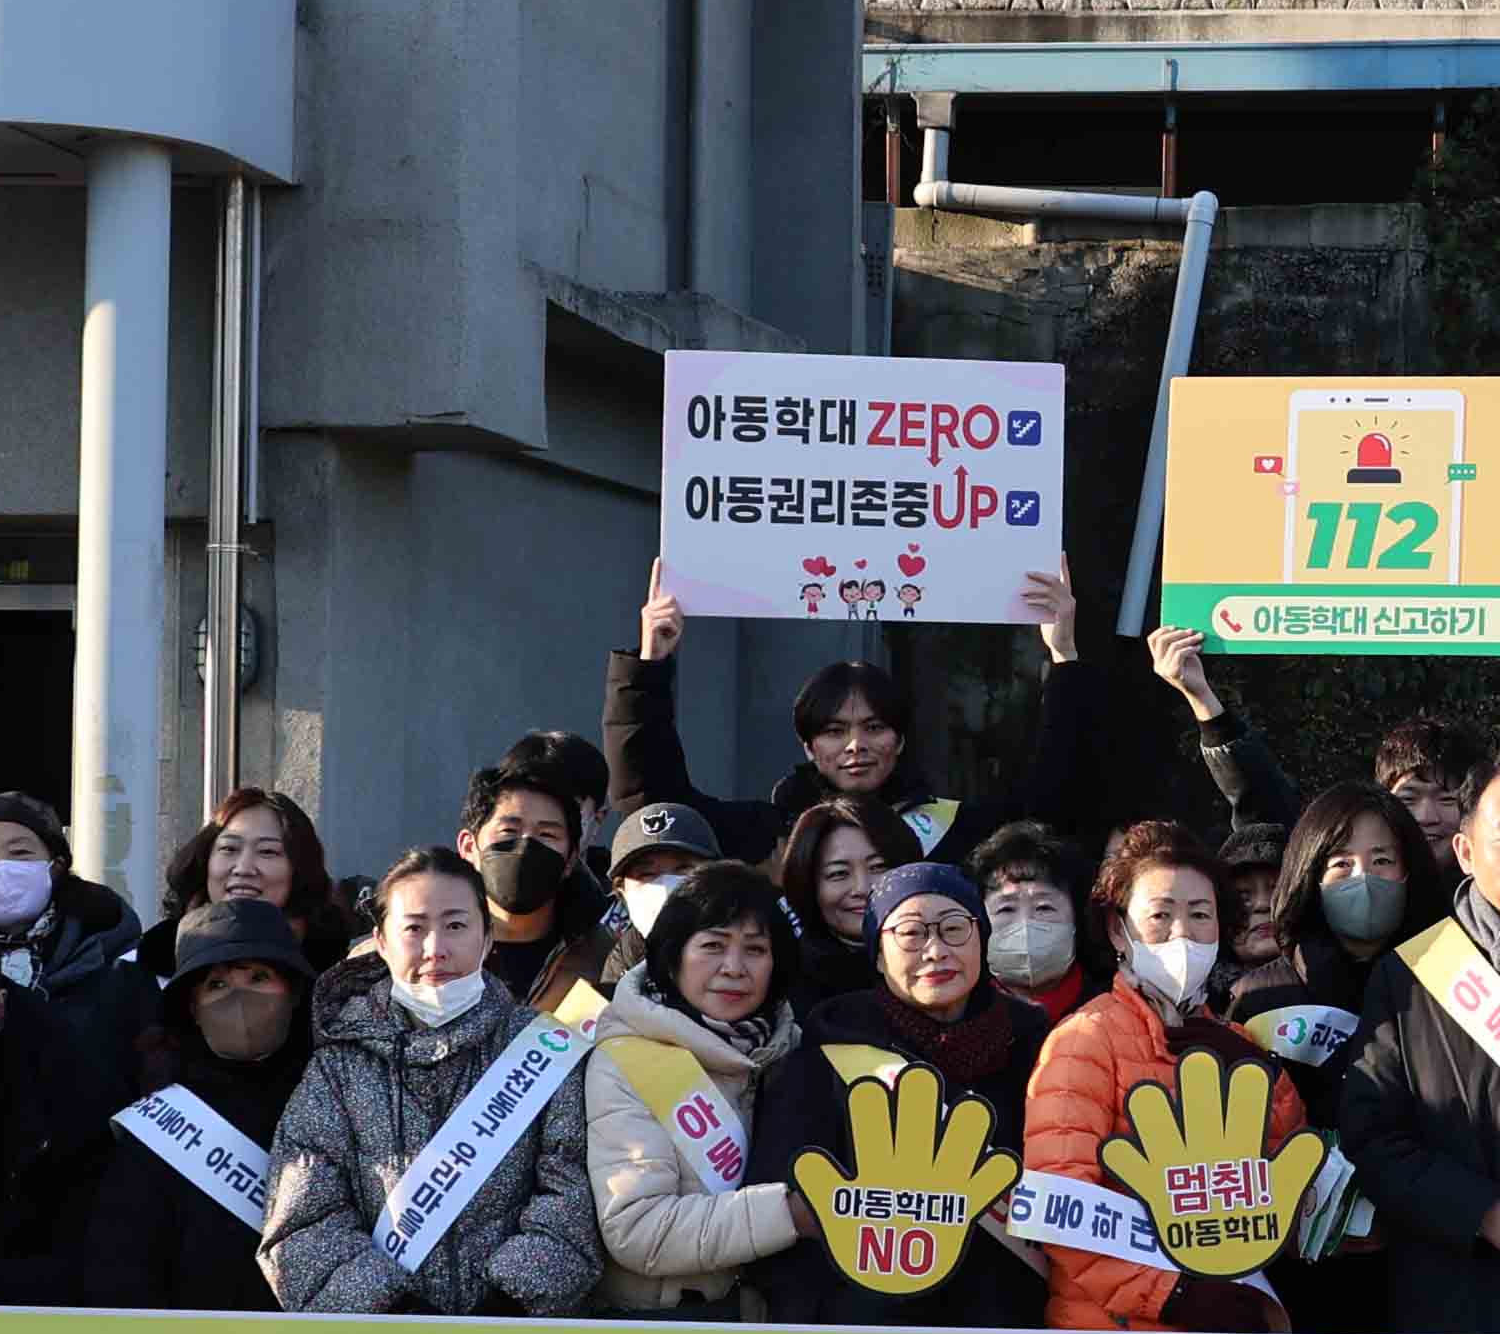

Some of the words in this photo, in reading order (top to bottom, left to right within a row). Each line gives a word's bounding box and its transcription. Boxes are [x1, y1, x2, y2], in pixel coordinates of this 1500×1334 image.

[686, 394, 857, 447] 아동학대
[866, 399, 1002, 452] ZERO
[1304, 501, 1439, 572] 112
[1252, 604, 1366, 639] 아동학대
[1371, 604, 1486, 639] 신고하기
[833, 1186, 966, 1224] 아동학대!
[1165, 1158, 1272, 1217] 멈춰!
[1010, 1183, 1159, 1255] 아동학대
[1166, 1213, 1280, 1249] 아동학대
[858, 1225, 937, 1276] NO
